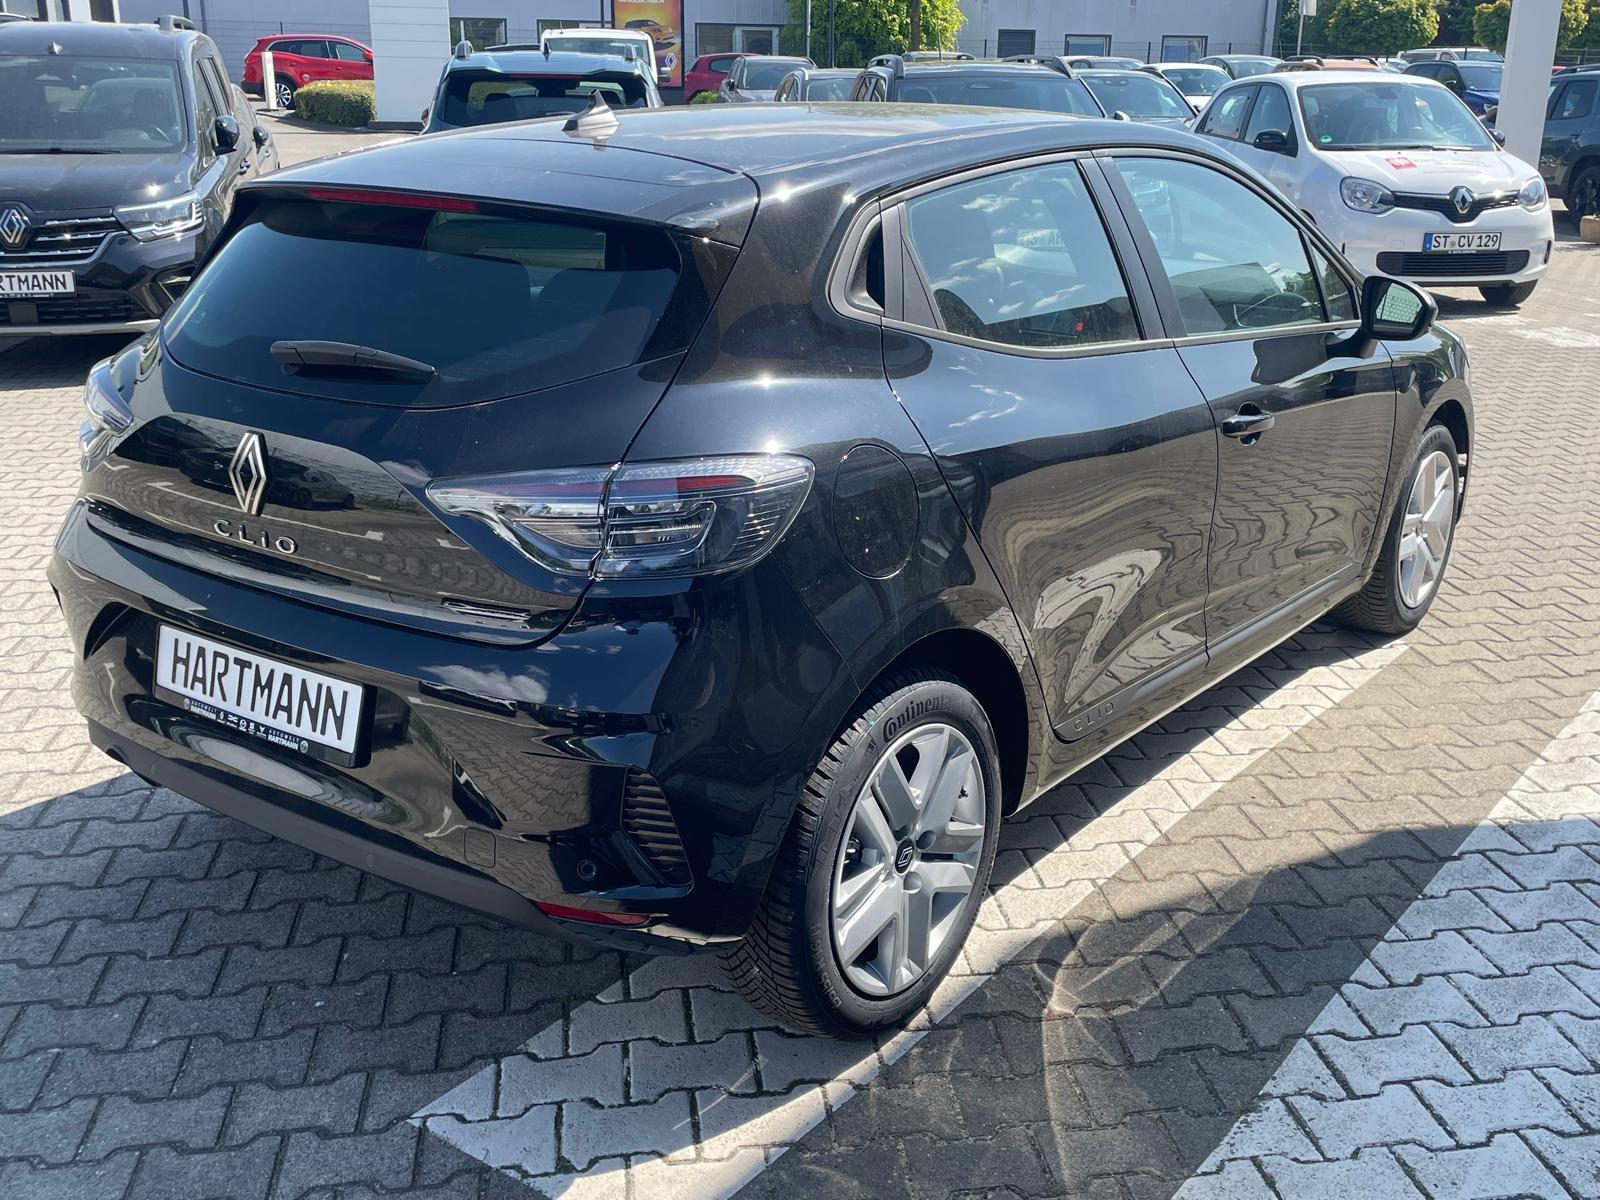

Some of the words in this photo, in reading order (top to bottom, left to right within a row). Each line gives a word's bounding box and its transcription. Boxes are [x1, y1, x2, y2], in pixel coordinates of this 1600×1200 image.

[1432, 235, 1450, 249] ST
[1457, 235, 1475, 248] CV
[1476, 234, 1499, 248] 129
[213, 519, 298, 555] CLIO
[171, 638, 348, 740] HARTMANN
[1074, 702, 1113, 731] CLIO
